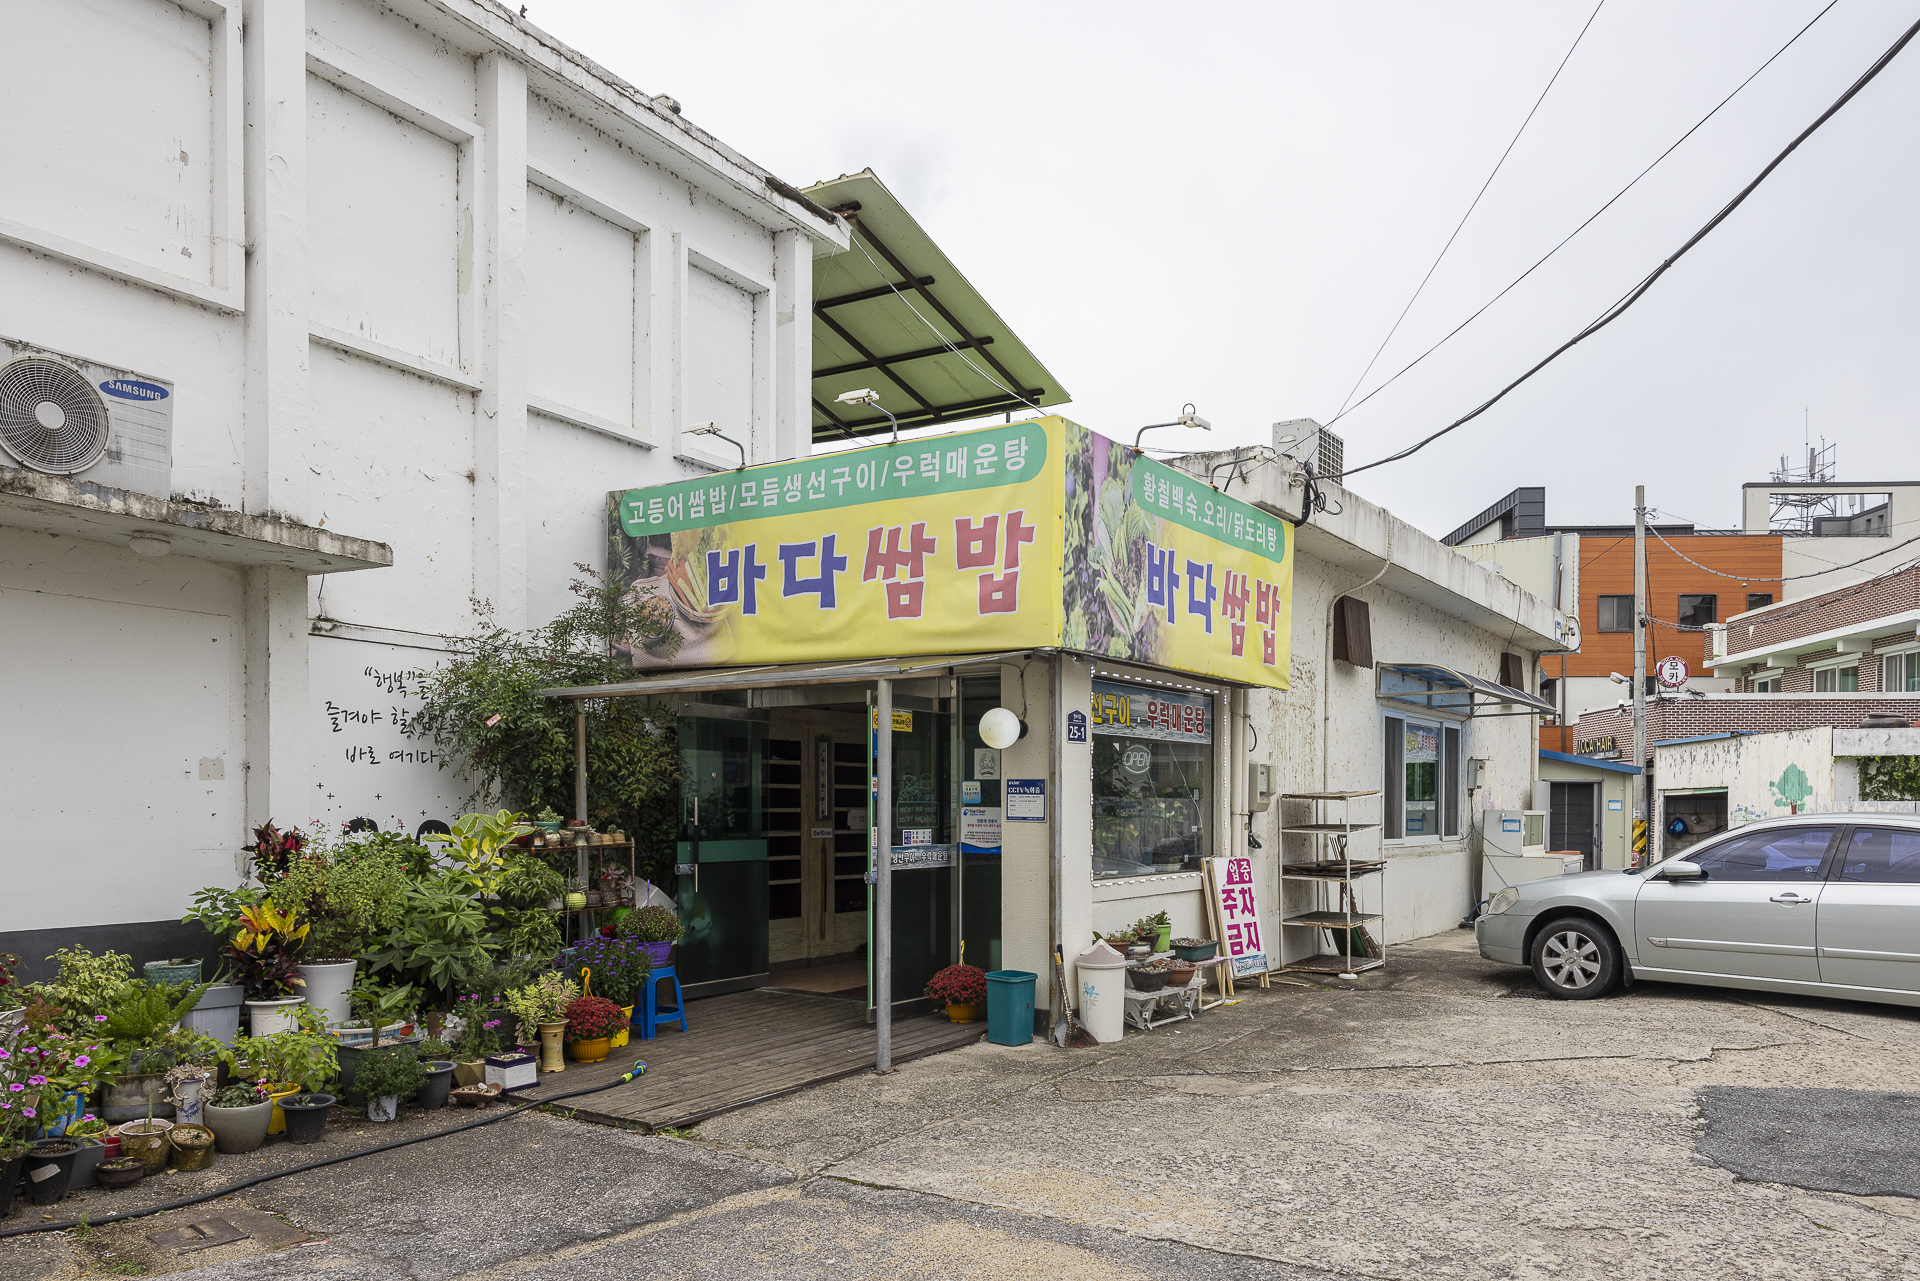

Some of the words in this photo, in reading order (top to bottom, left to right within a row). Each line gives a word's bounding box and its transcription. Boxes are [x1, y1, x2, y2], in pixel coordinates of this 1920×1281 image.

[108, 380, 161, 401] SAMSUNG
[706, 508, 1038, 622] 바다쌈밥
[1146, 540, 1282, 668] 바다쌈밥
[1669, 661, 1679, 682] 모카
[325, 701, 383, 733] 즐겨야
[1147, 700, 1206, 734] 우럭매운탕
[1070, 726, 1085, 740] 25-1
[1596, 736, 1613, 752] HAIR
[345, 746, 381, 765] 바로
[389, 749, 439, 764] 여기다
[1124, 751, 1151, 767] OPEN
[1221, 886, 1256, 920] 주차
[1226, 921, 1262, 956] 금지
